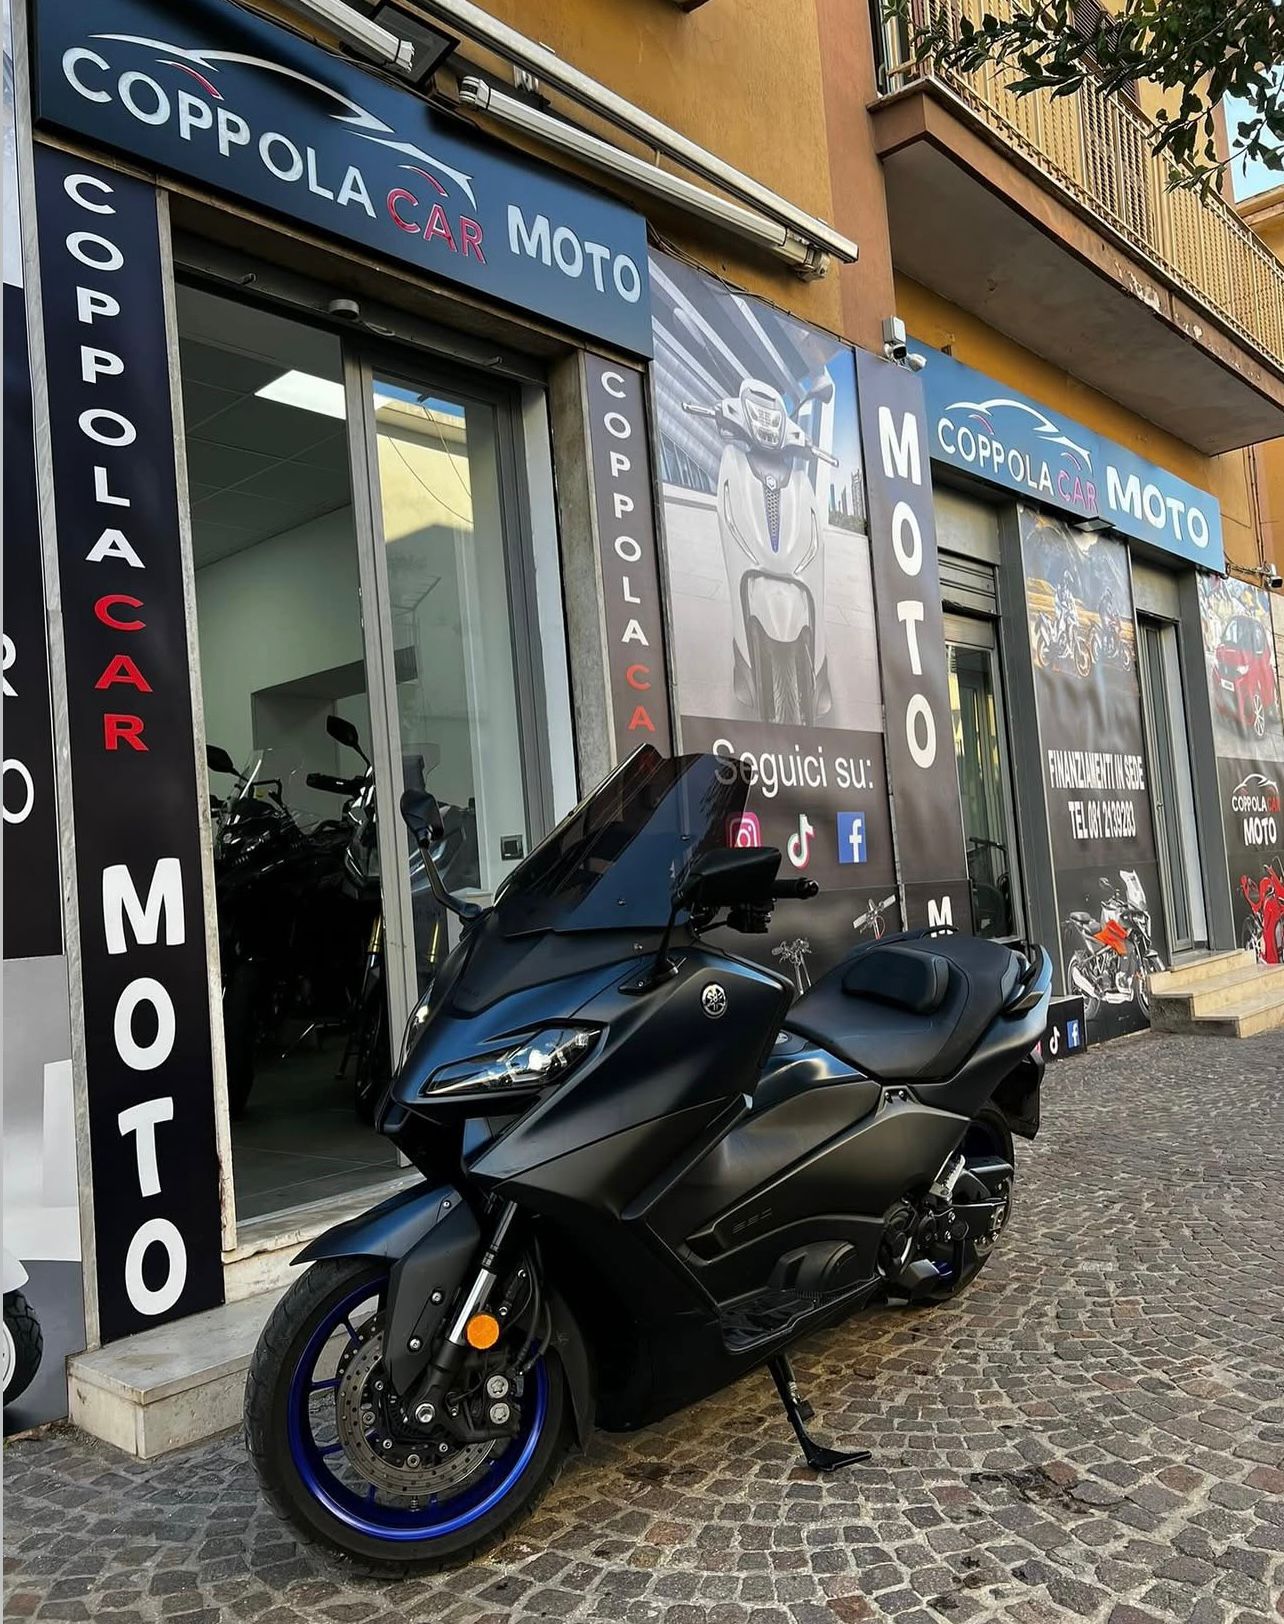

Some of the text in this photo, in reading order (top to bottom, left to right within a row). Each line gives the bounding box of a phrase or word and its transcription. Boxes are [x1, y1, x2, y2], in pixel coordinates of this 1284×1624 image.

[61, 47, 642, 303] COPPOLA CAR MOTO
[601, 371, 649, 647] COPPOLA
[937, 418, 1209, 549] COPPOLA CAR MOTO
[878, 406, 937, 769] MOTO
[63, 173, 188, 1316] COPPOLA CAR MOTO
[712, 739, 874, 798] Seguici su:
[1114, 754, 1125, 789] IN
[1124, 754, 1145, 790] SEDE
[1068, 800, 1136, 839] TEL 081 2139283
[1232, 796, 1267, 812] COPPOLA
[1244, 817, 1277, 846] MOTO
